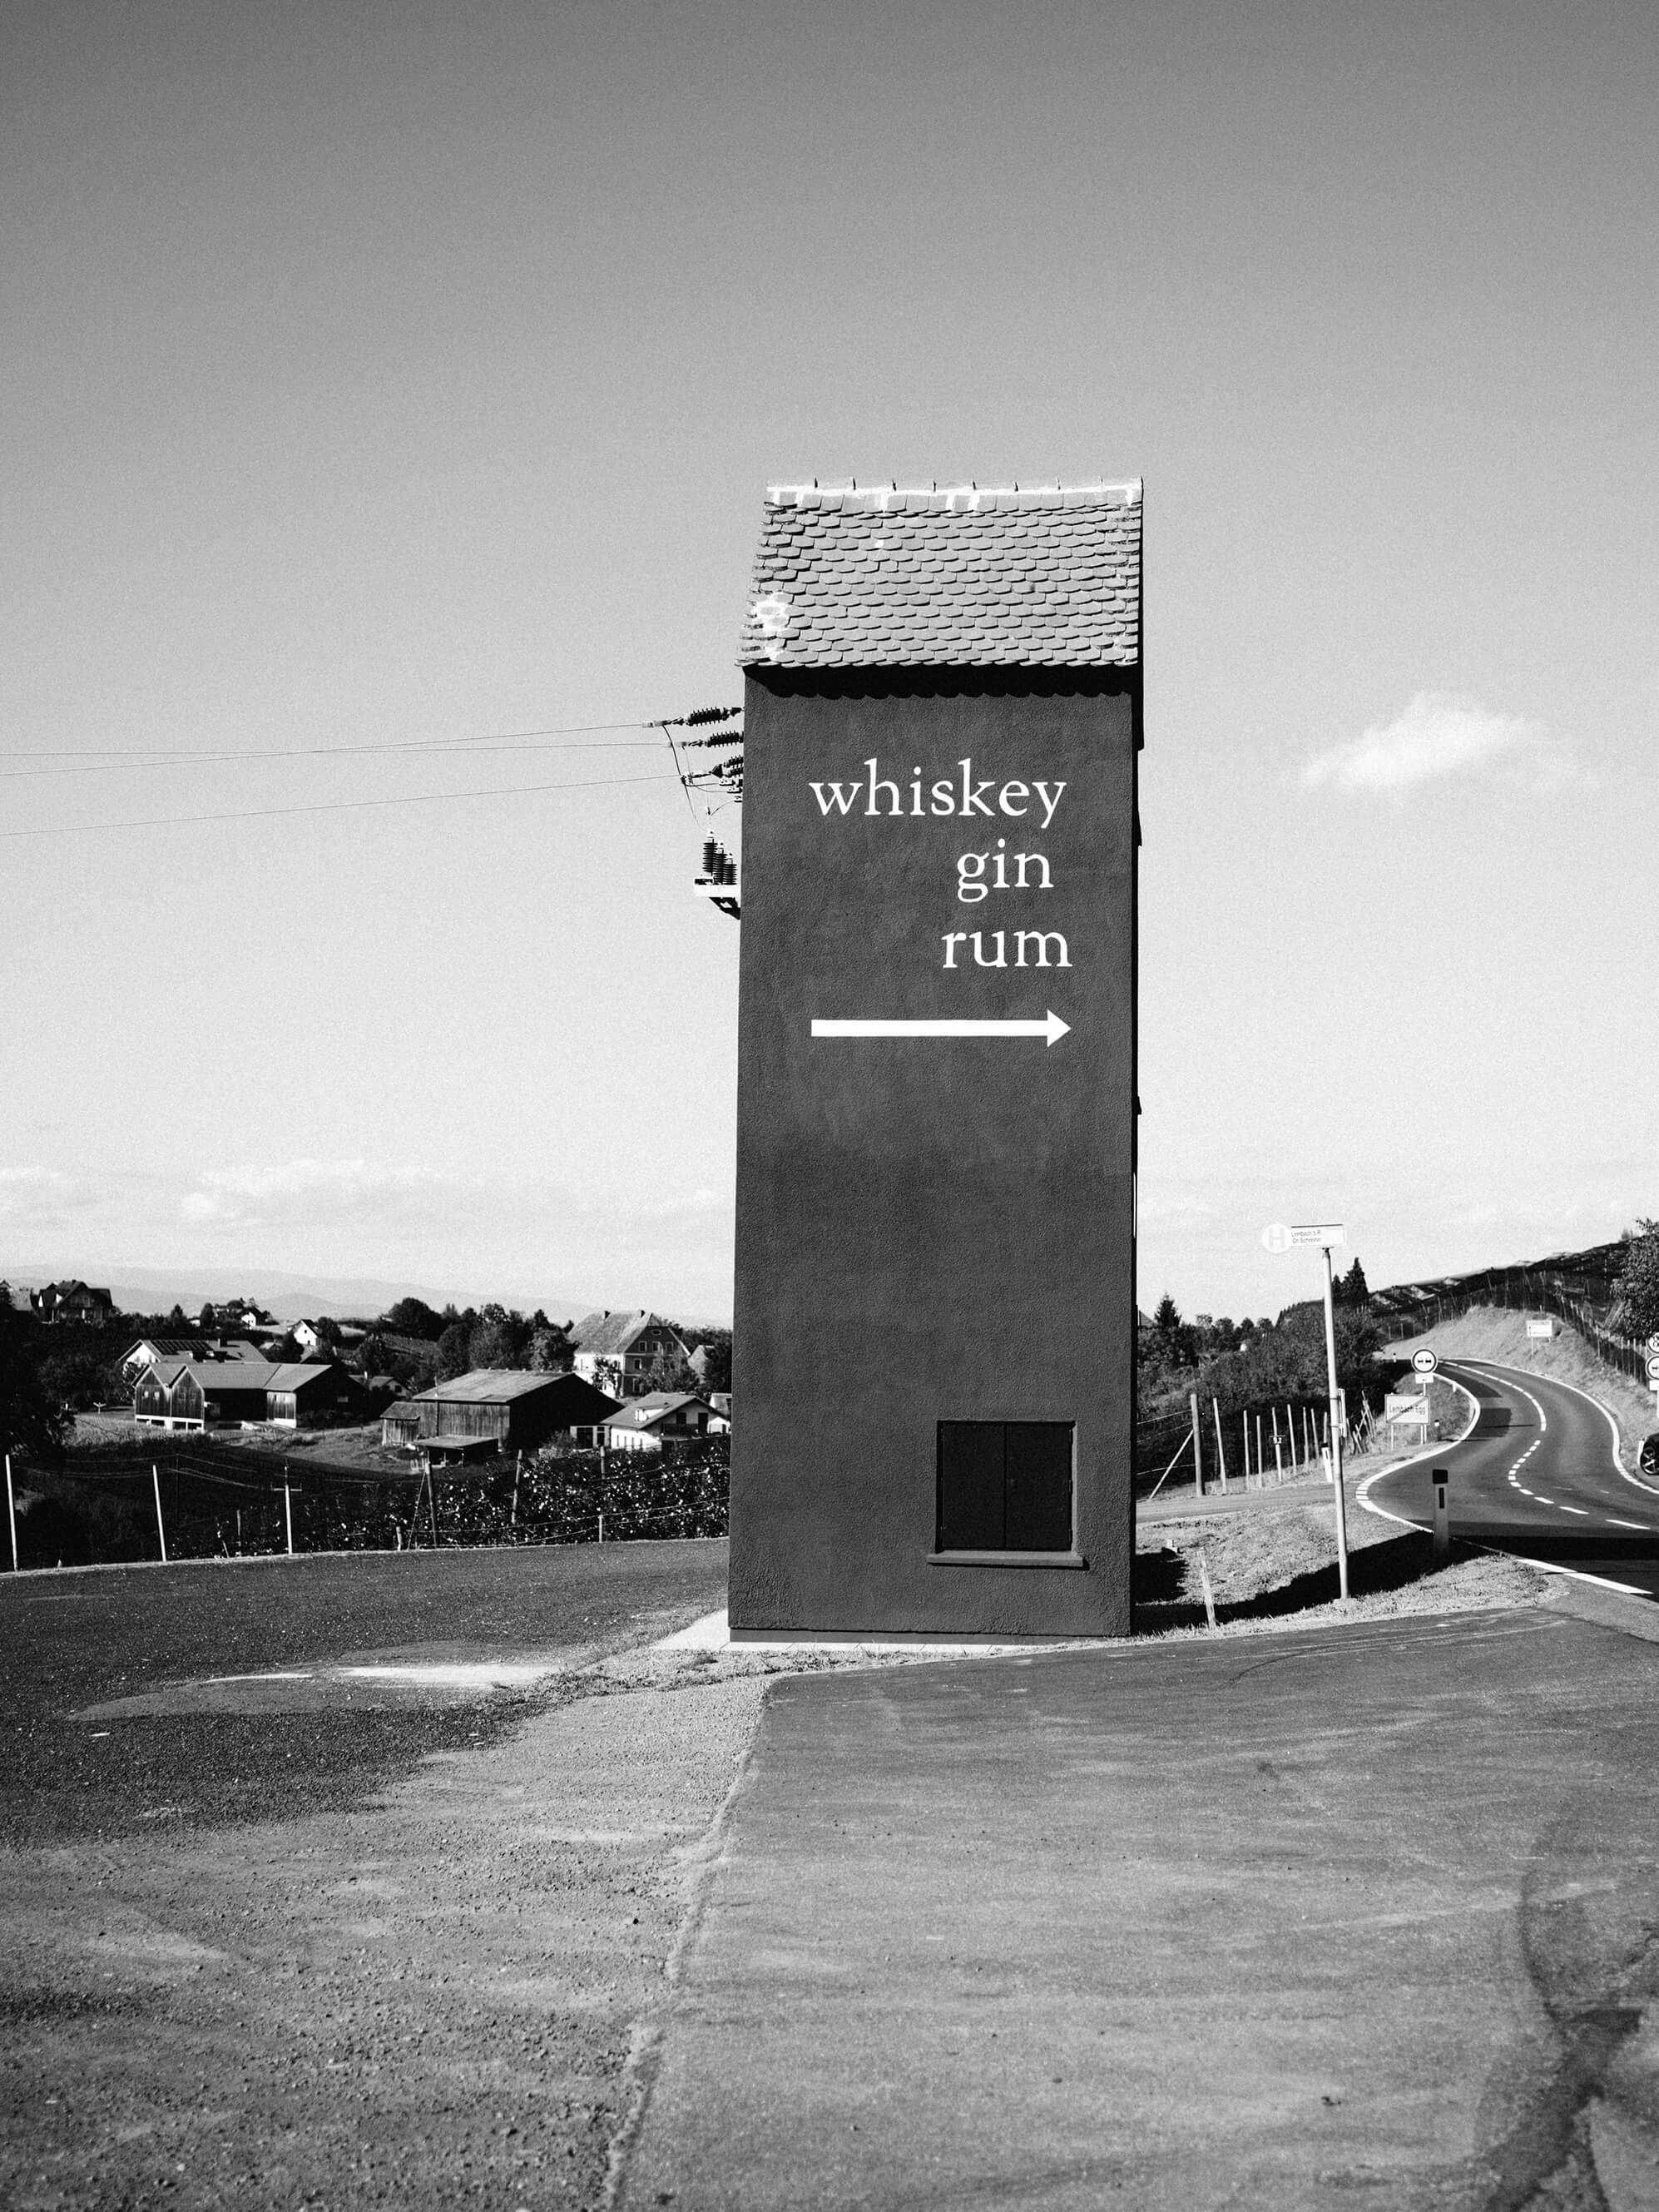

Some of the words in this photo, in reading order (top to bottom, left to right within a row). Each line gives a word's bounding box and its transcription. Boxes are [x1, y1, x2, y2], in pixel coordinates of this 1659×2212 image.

[809, 757, 1067, 829] whiskey
[957, 838, 1054, 903] gin
[941, 930, 1072, 969] rum
